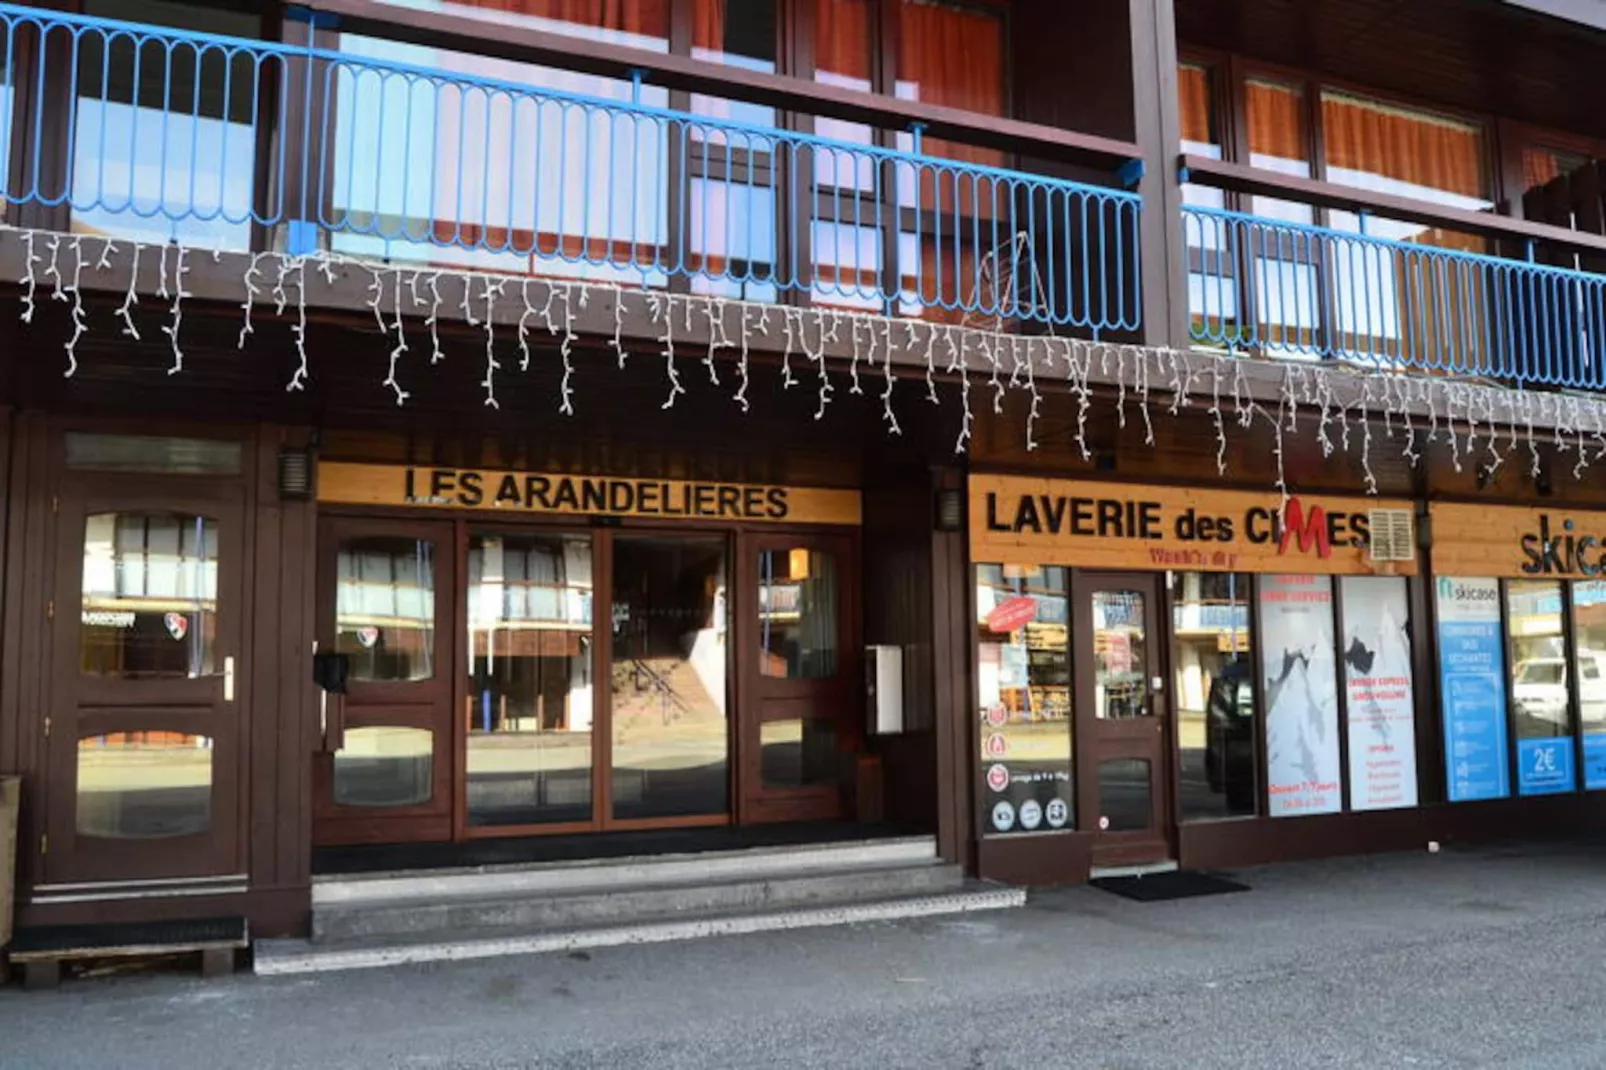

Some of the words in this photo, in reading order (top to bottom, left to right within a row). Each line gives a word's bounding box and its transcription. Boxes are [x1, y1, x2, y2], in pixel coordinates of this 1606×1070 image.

[404, 468, 483, 506] LES
[495, 473, 788, 518] ARANDELIERES
[985, 492, 1163, 540] LAVERIE
[1175, 508, 1234, 542] des
[1245, 497, 1369, 559] CIMES
